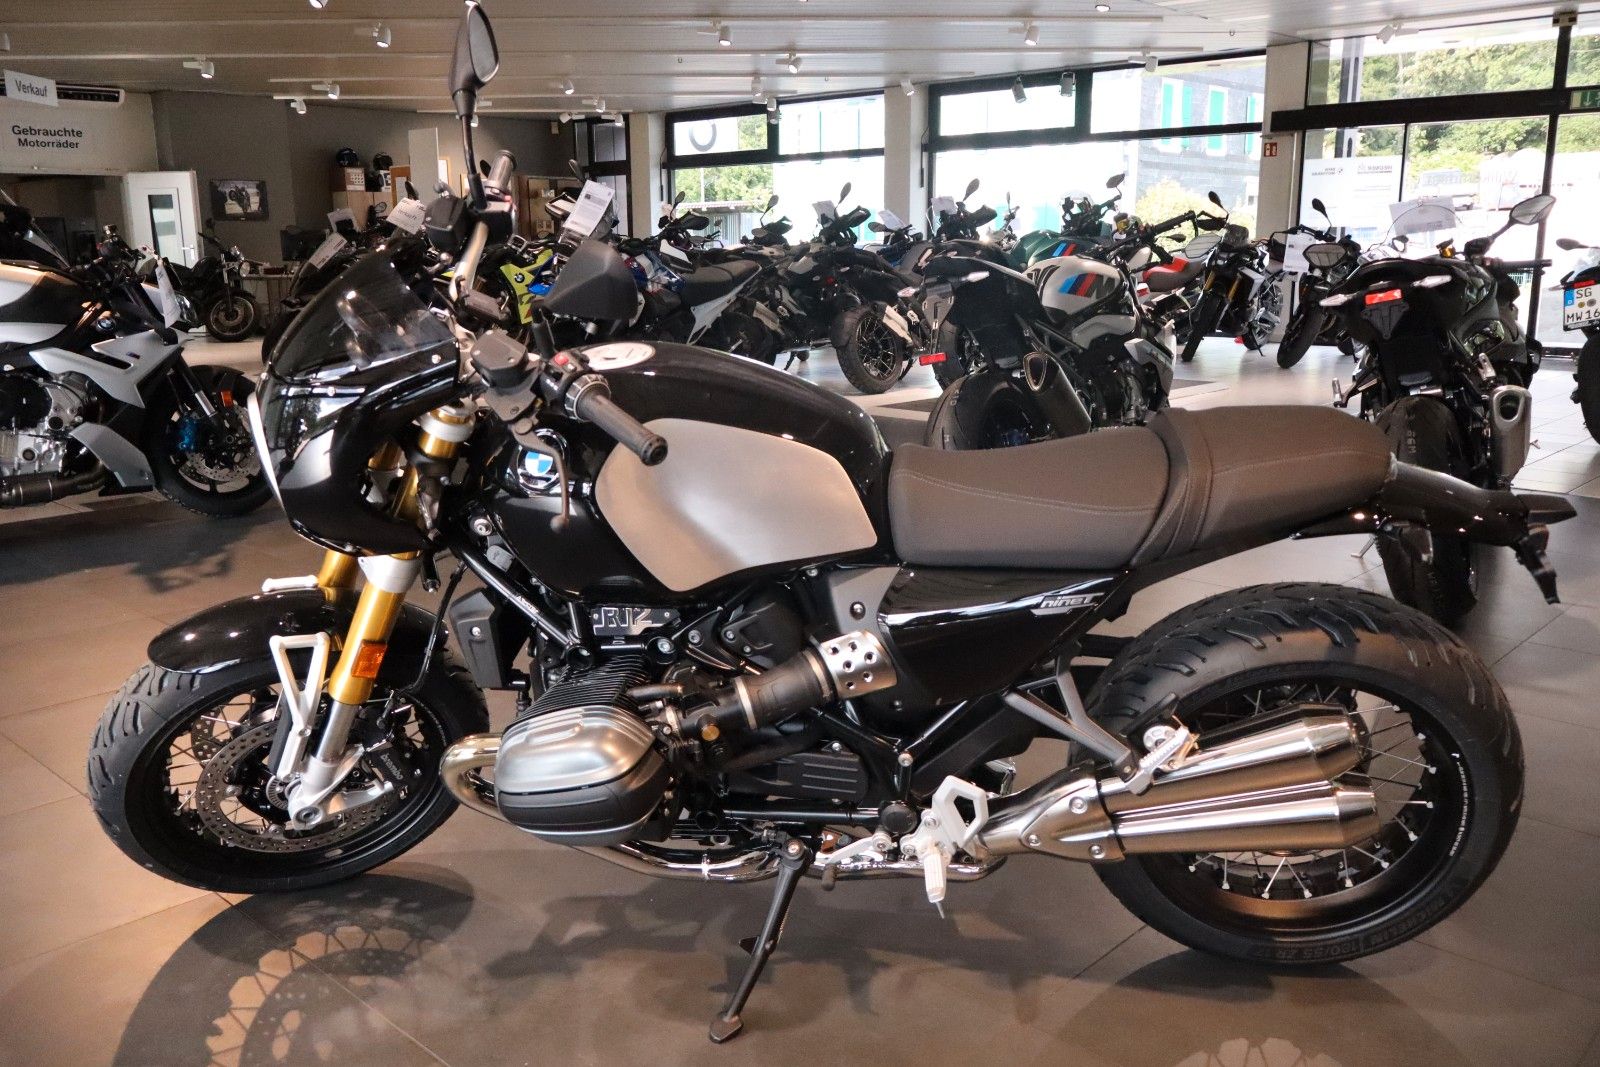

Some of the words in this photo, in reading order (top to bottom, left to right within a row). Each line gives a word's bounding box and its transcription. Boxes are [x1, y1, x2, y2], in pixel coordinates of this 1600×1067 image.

[15, 79, 48, 97] Verkauf
[12, 125, 83, 138] Gebrauchte
[18, 138, 80, 149] Motorräder
[1576, 287, 1592, 299] SG
[1566, 311, 1583, 323] MW
[601, 607, 654, 628] R12
[380, 753, 404, 780] brembo
